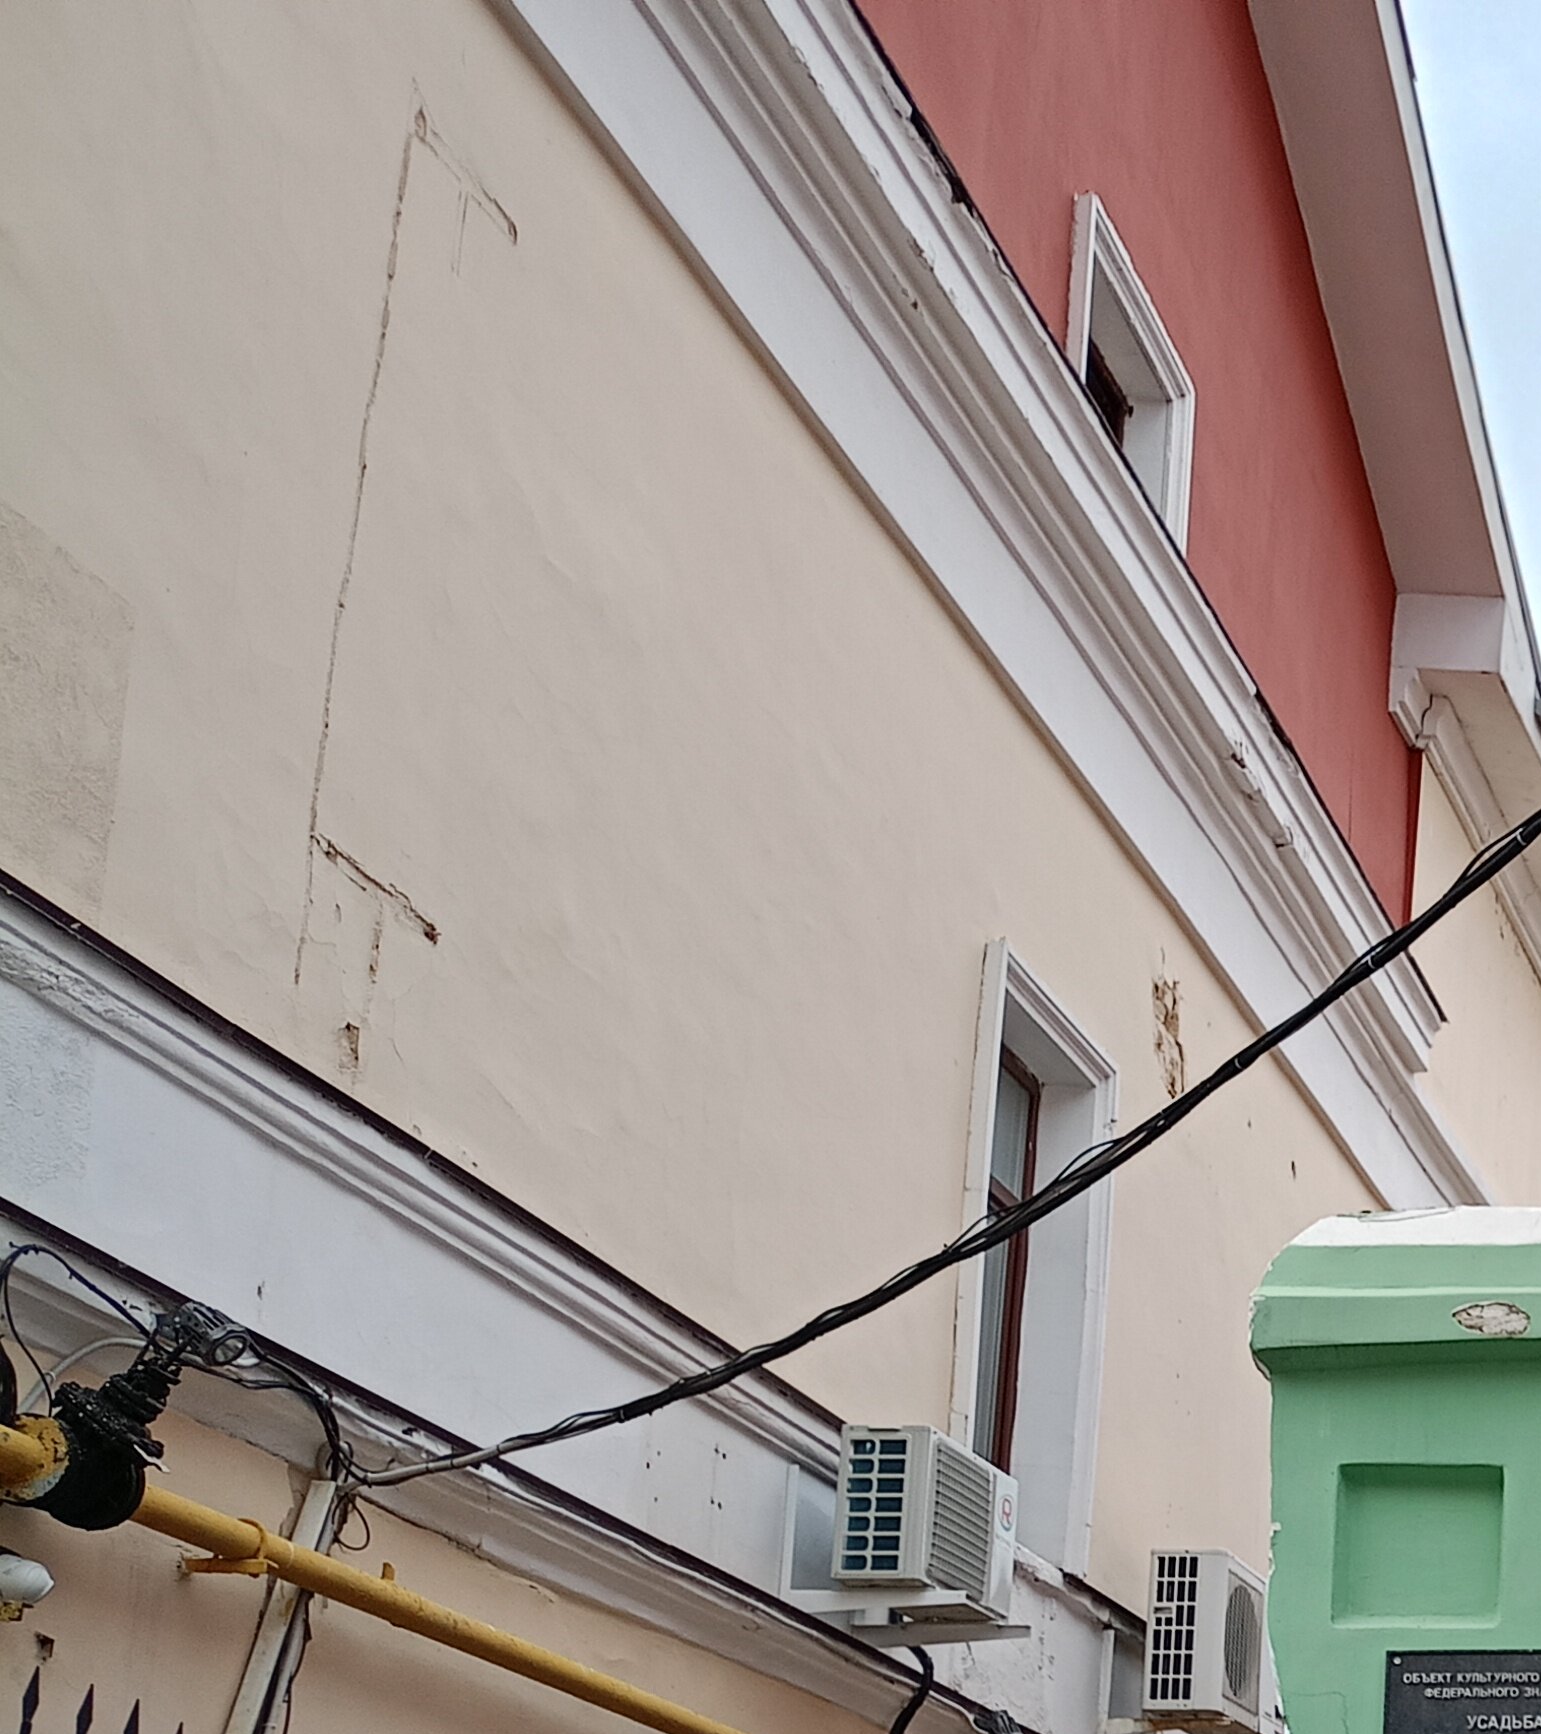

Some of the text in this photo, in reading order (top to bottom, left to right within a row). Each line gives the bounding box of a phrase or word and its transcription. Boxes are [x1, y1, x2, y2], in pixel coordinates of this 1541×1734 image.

[1403, 1672, 1452, 1684] ОБЪЕКТ
[1456, 1672, 1540, 1683] КУЛЬТУРНОГО
[1424, 1687, 1519, 1699] ФЕДЕРАЛЬНОГО
